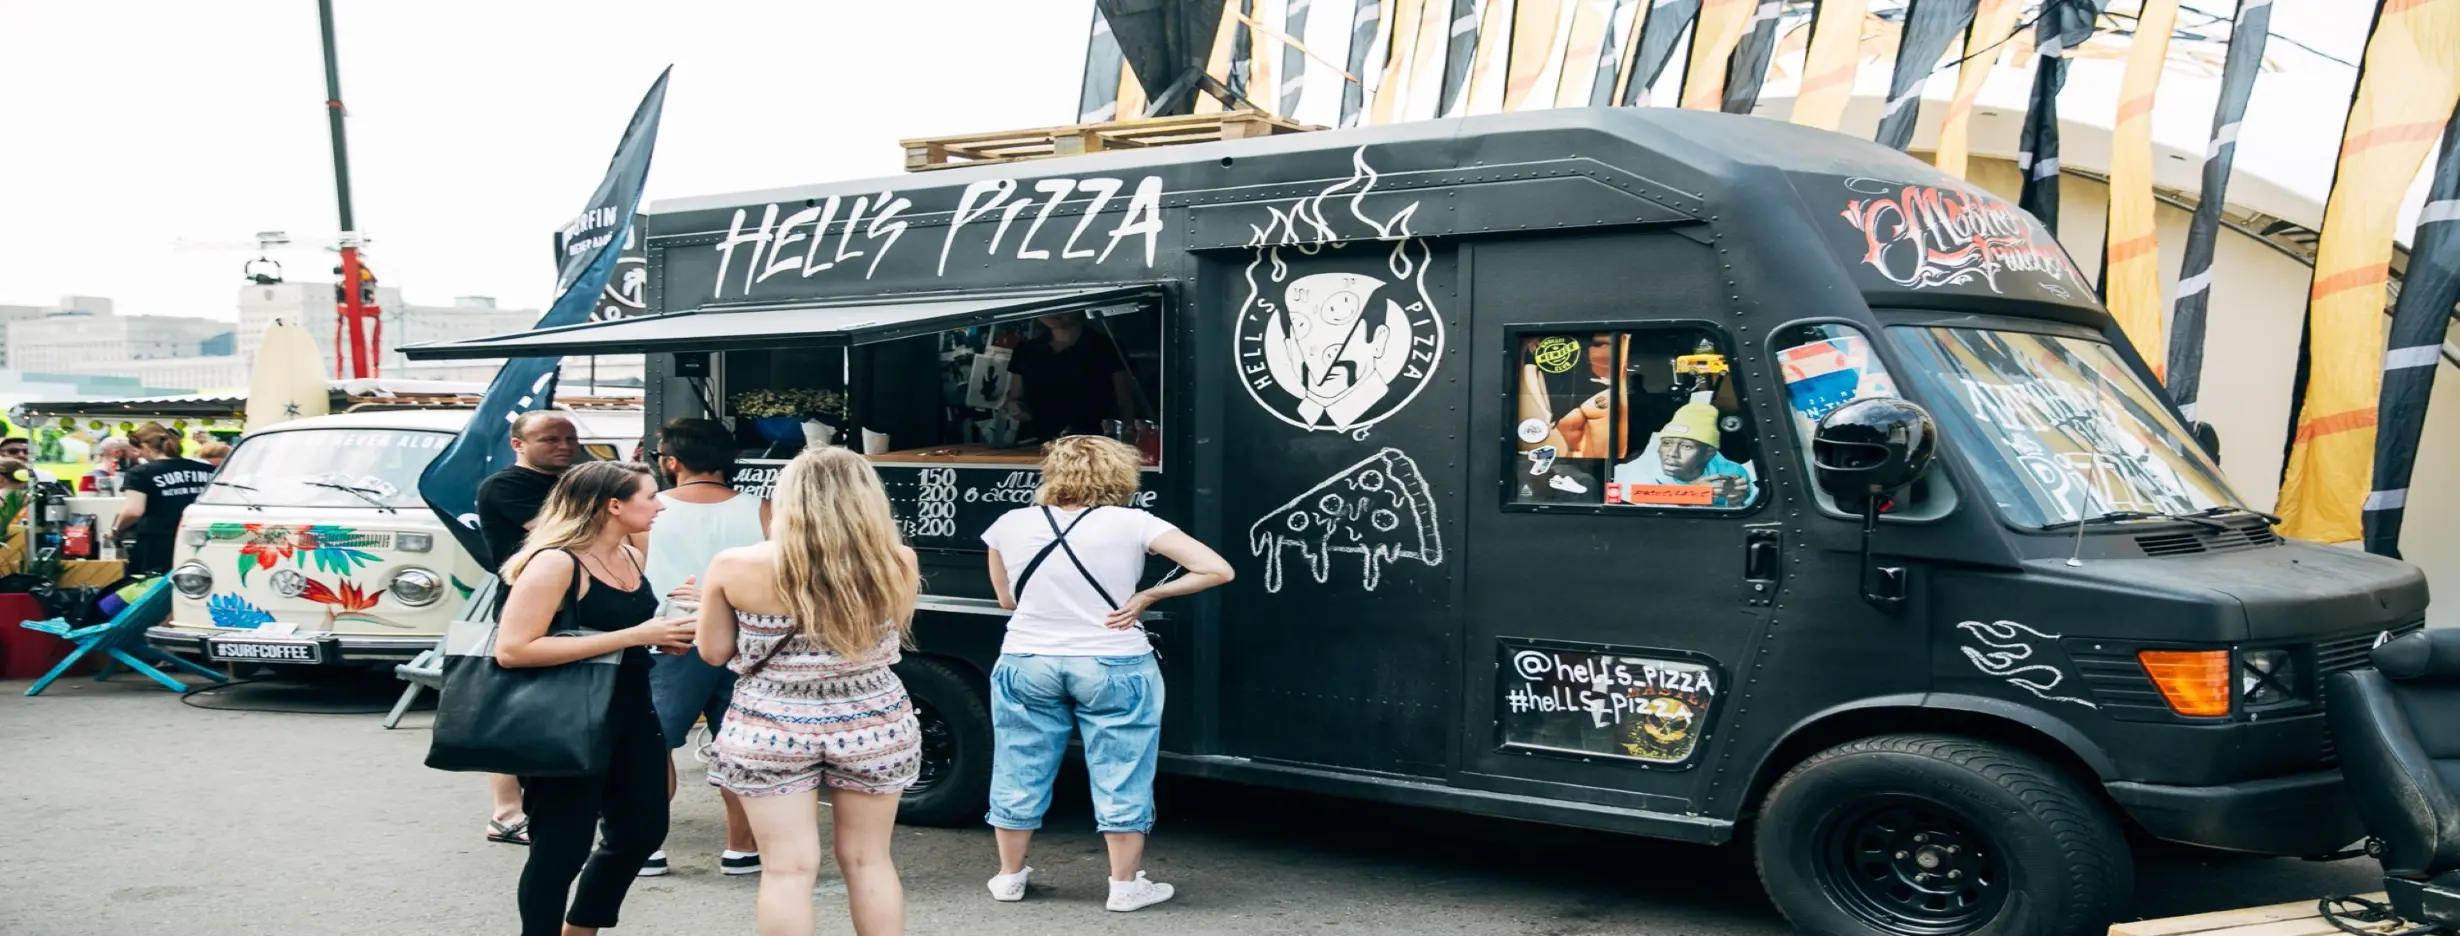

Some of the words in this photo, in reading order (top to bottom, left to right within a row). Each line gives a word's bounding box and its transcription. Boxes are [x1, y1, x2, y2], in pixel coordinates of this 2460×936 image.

[714, 191, 912, 298] HELL'S
[938, 176, 1163, 277] PIZZA
[1244, 298, 1275, 390] HELL'S
[1404, 301, 1435, 380] PIZZA
[917, 468, 957, 486] 150
[918, 486, 958, 502] 200
[917, 502, 956, 518] 200
[917, 518, 956, 536] 200
[217, 643, 310, 659] #SURFCOFFEE
